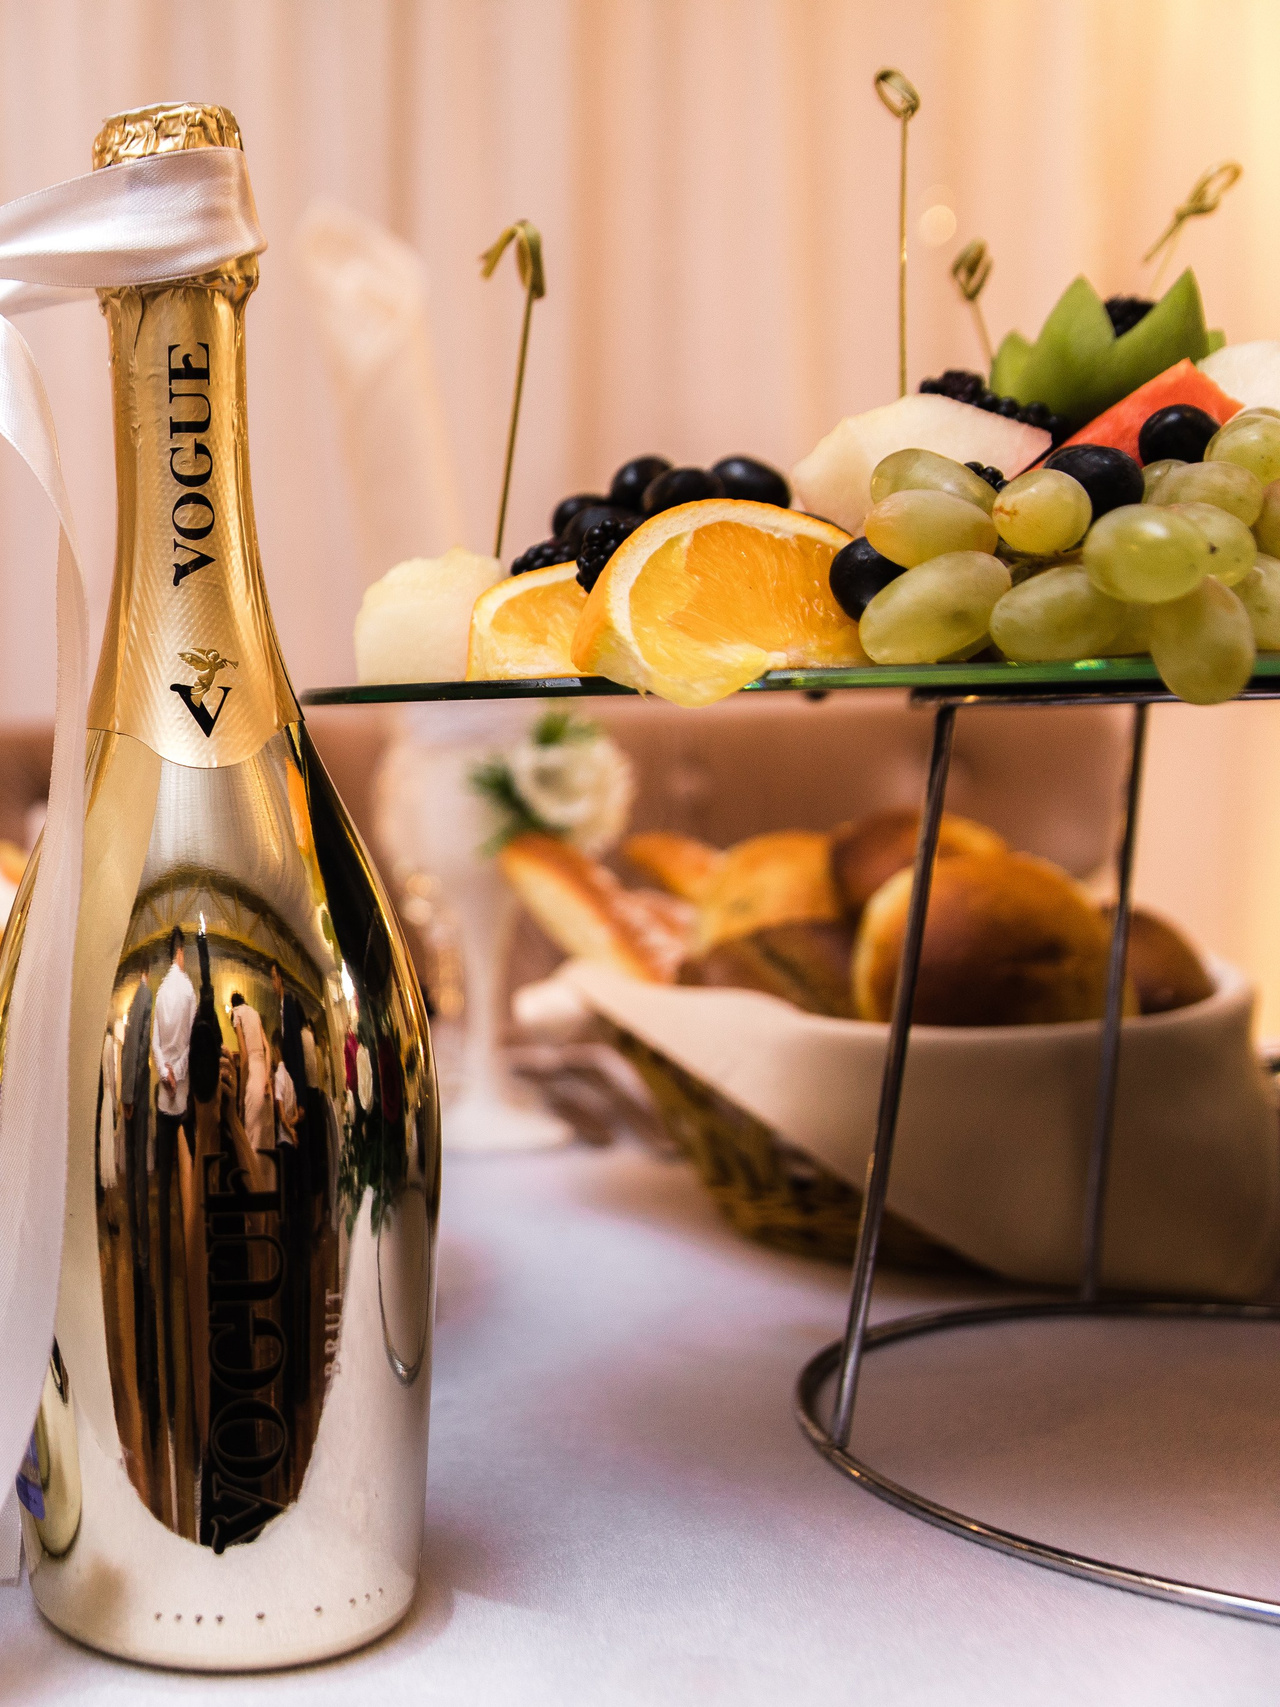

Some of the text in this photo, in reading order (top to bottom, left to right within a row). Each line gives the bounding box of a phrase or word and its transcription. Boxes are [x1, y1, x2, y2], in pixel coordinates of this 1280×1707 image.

[167, 341, 216, 587] VOGUE
[169, 683, 232, 738] V
[202, 1147, 289, 1555] VOGUE
[324, 1288, 342, 1376] BRUT
